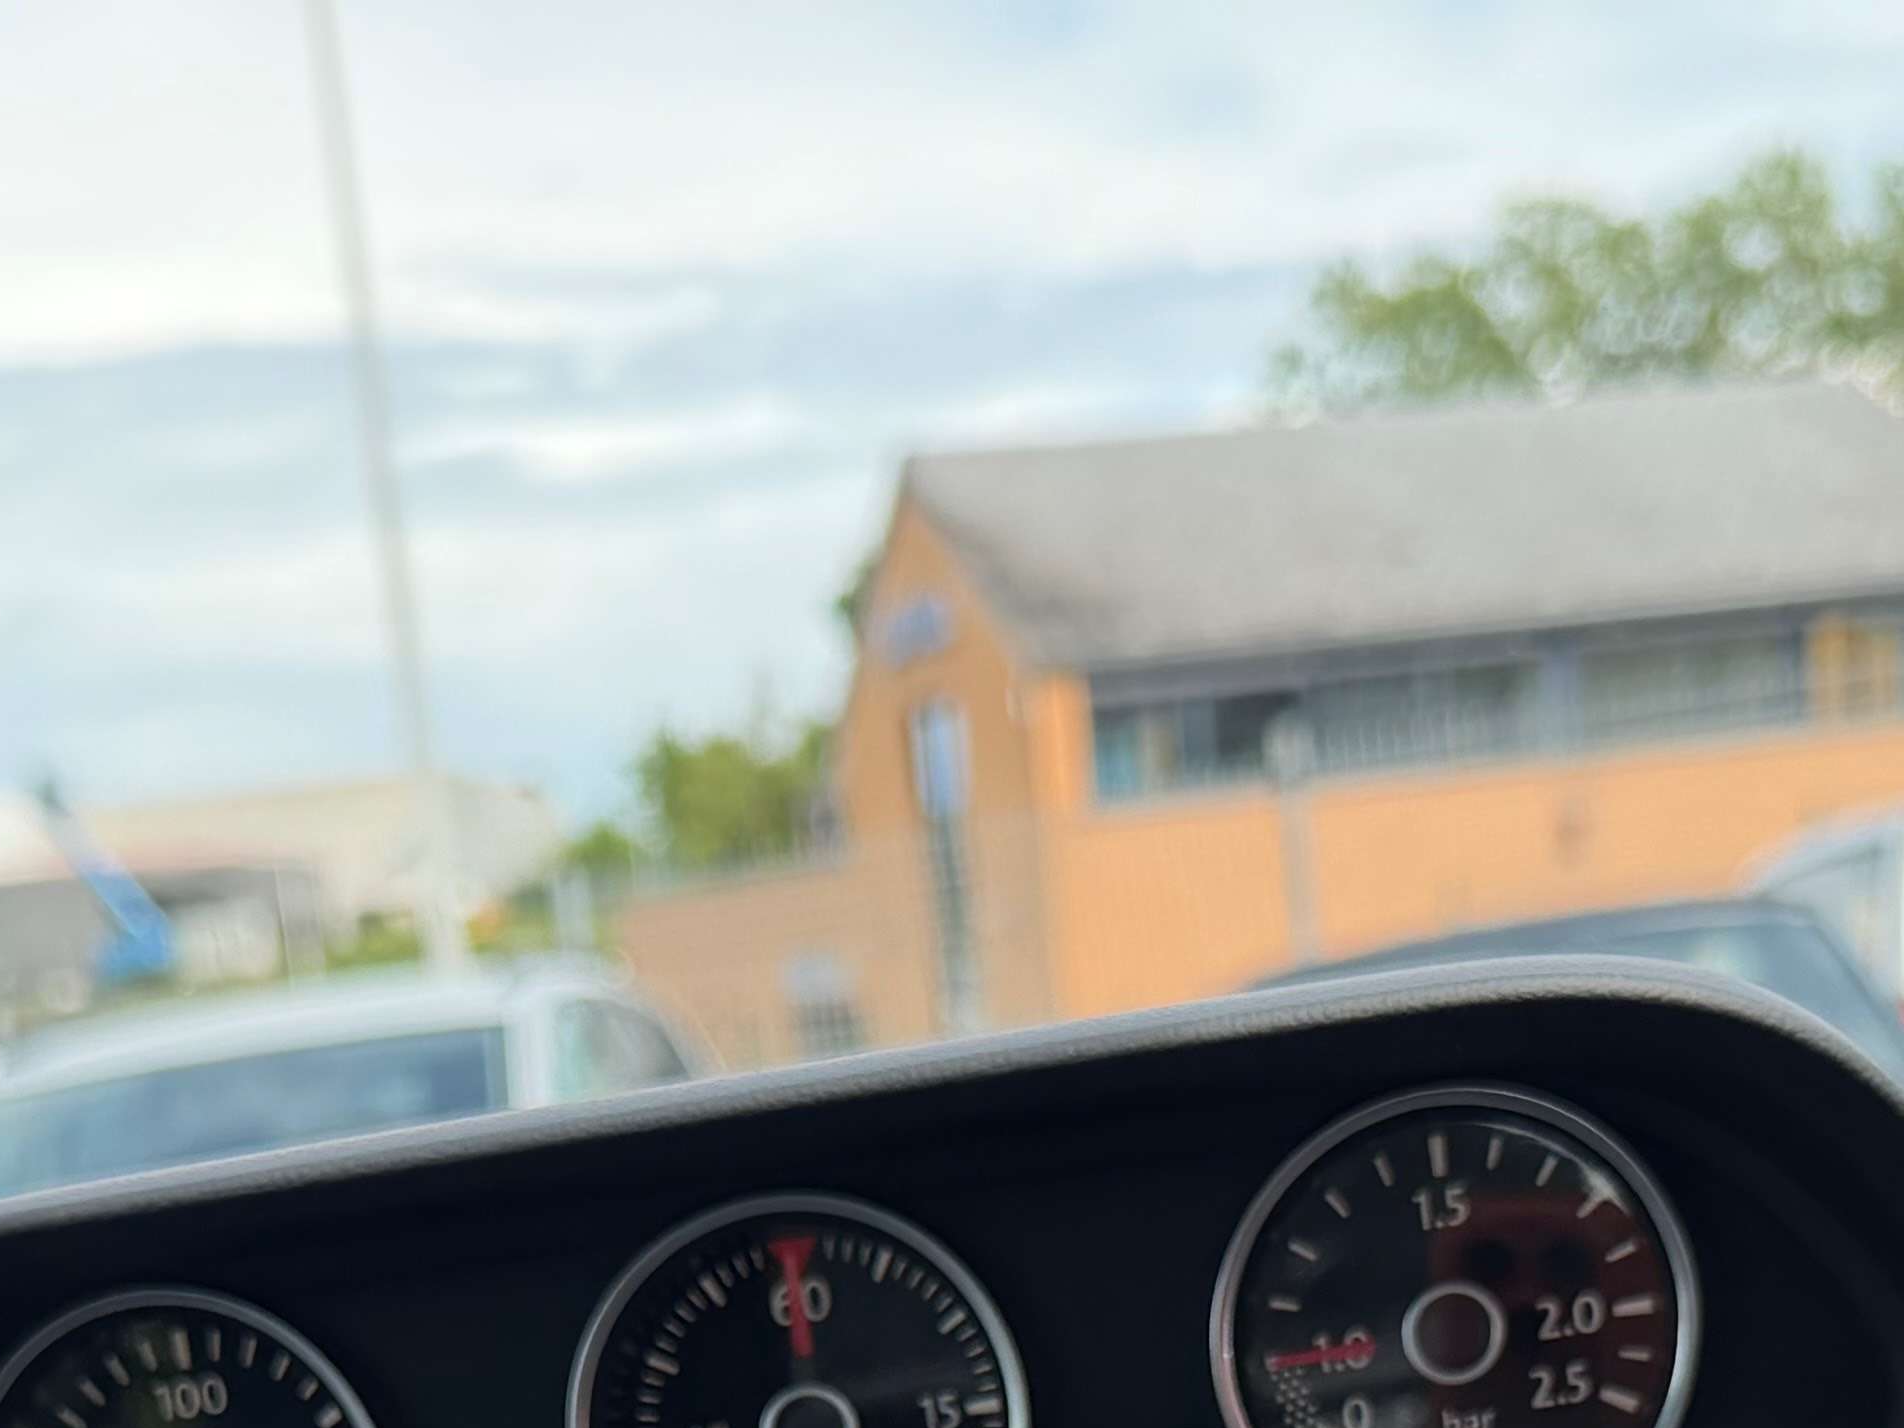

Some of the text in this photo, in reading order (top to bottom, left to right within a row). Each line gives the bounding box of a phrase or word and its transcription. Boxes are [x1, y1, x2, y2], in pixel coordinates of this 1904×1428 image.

[1413, 1187, 1471, 1231] 1.5
[1535, 1295, 1605, 1341] 2.0
[155, 1374, 228, 1421] 100
[1528, 1366, 1594, 1411] 2.5
